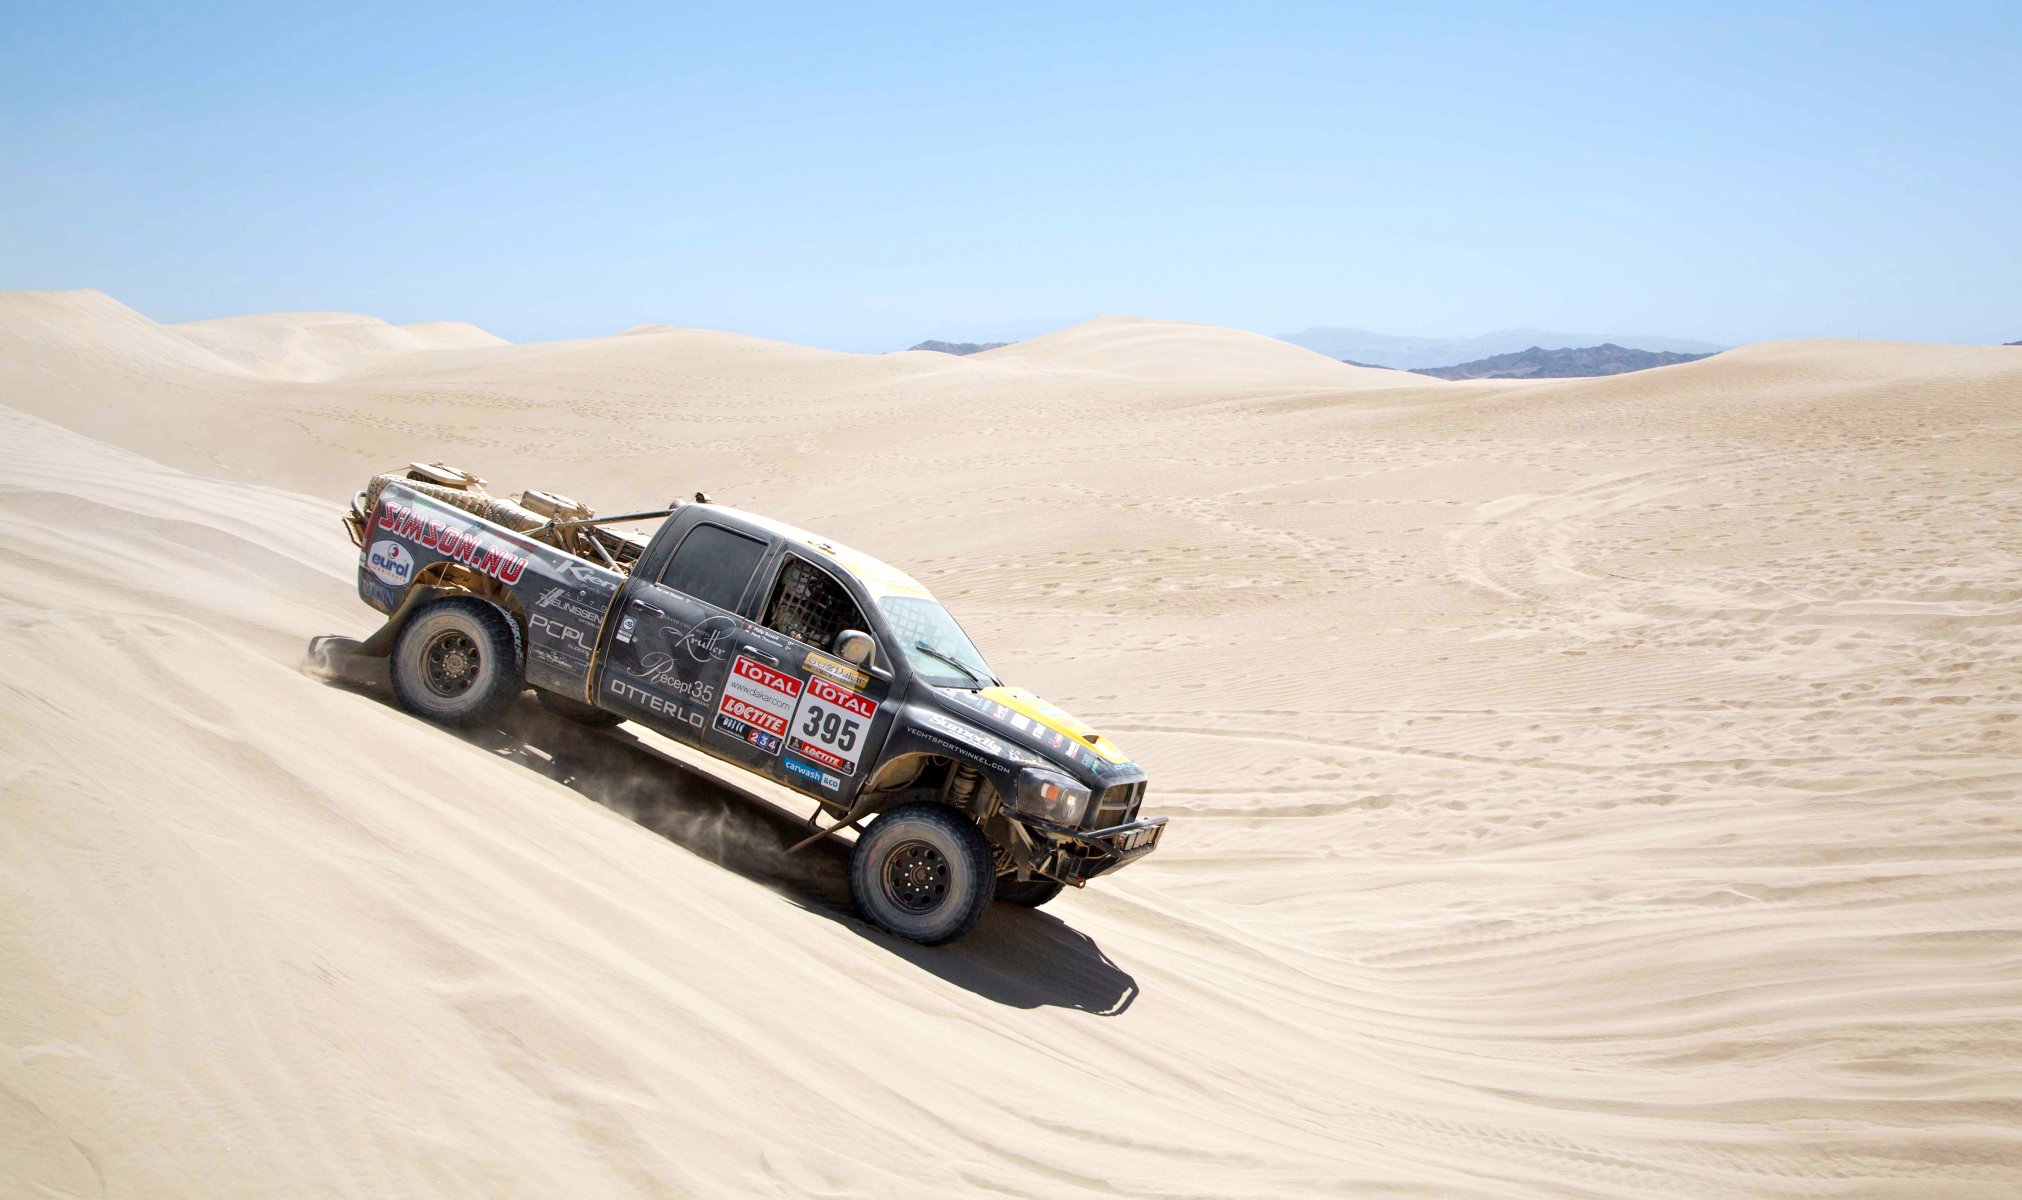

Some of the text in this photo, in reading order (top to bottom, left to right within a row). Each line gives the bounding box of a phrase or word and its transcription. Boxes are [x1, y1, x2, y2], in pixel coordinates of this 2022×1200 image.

[378, 501, 528, 585] SIMSON.NU
[371, 552, 410, 578] eurol
[528, 613, 592, 651] PCPL
[730, 681, 791, 711] www.dakar.com
[740, 659, 797, 696] TOTAL
[610, 679, 704, 728] OTTERLO
[724, 699, 782, 732] LOCTITE
[813, 678, 871, 717] TOTAL
[802, 705, 861, 753] 395
[803, 745, 840, 766] LOCTITE
[907, 725, 1010, 775] VECHTSPORTWINKEL.COM
[785, 760, 838, 788] carwash &co
